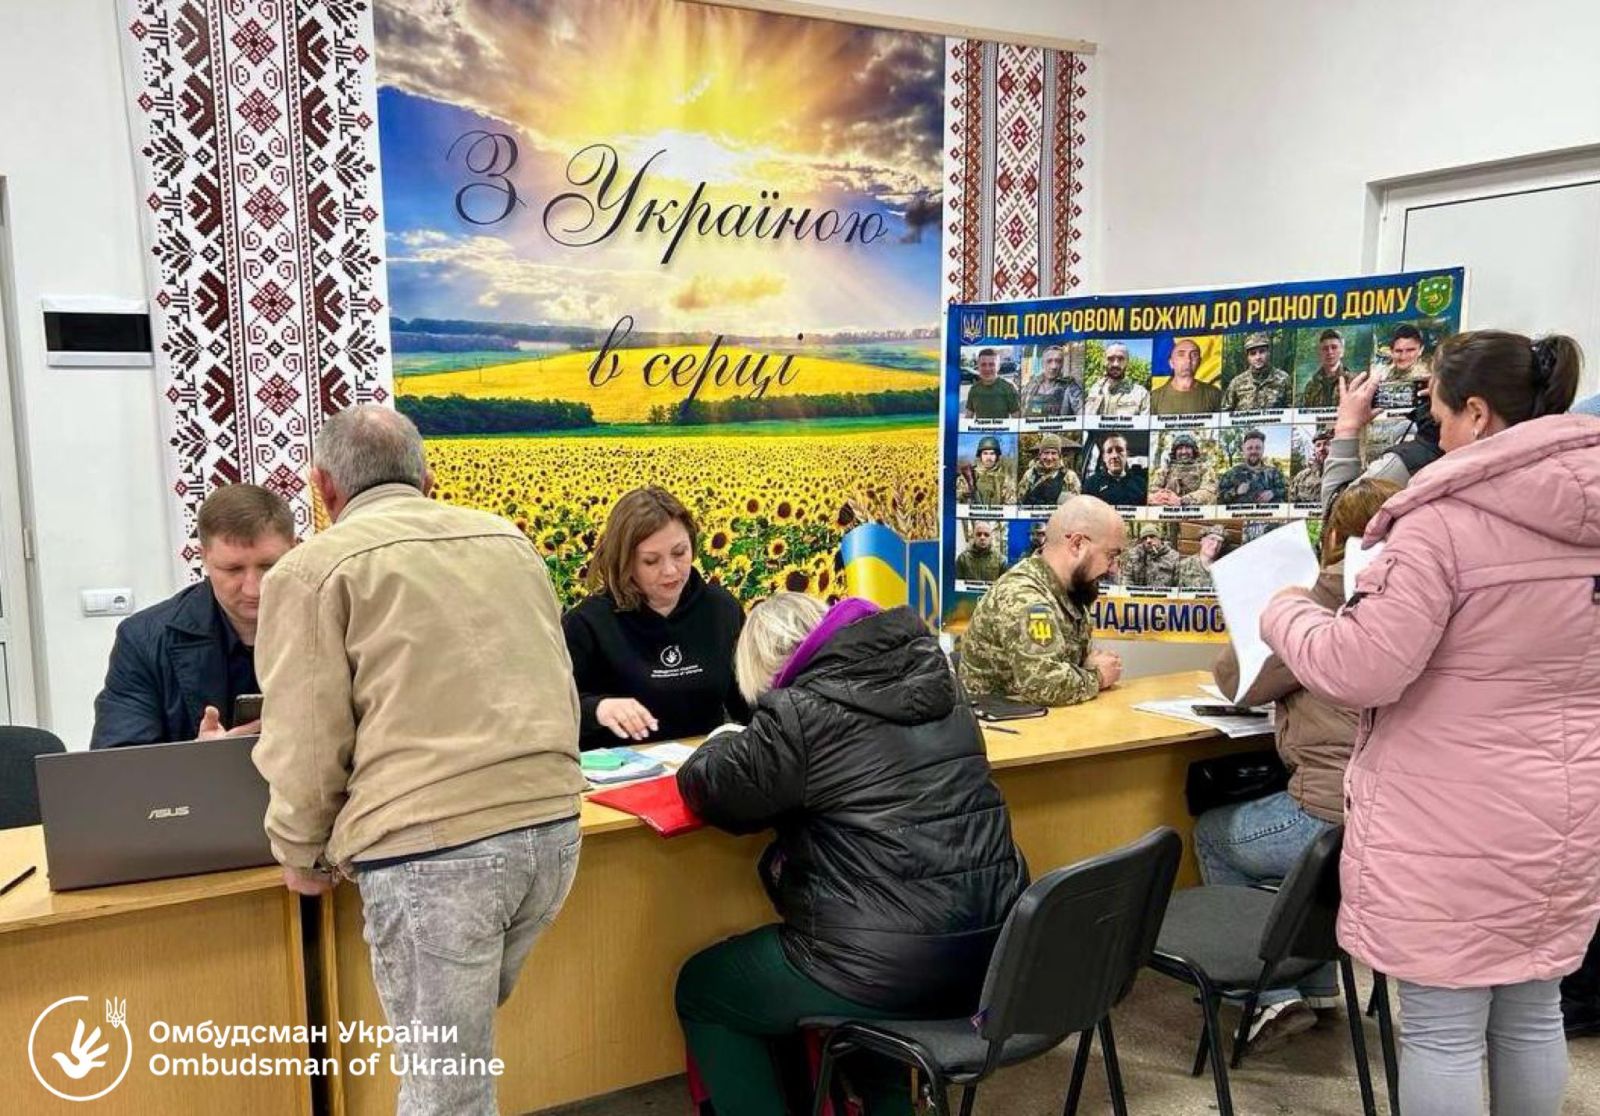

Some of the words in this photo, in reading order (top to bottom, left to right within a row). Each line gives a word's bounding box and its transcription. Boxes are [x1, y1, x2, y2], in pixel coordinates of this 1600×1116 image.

[446, 130, 527, 225] З
[543, 143, 888, 264] Україною
[987, 313, 1019, 340] ПІД
[1024, 307, 1123, 337] ПОКРОВОМ
[1130, 303, 1206, 332] БОЖИМ
[1210, 301, 1242, 330] ДО
[1246, 293, 1336, 325] РІДНОГО
[1342, 286, 1413, 320] ДОМУ
[587, 315, 635, 389] в
[643, 333, 804, 414] серці
[1090, 601, 1226, 633] НАДІЄМОС
[147, 806, 190, 820] ASUS
